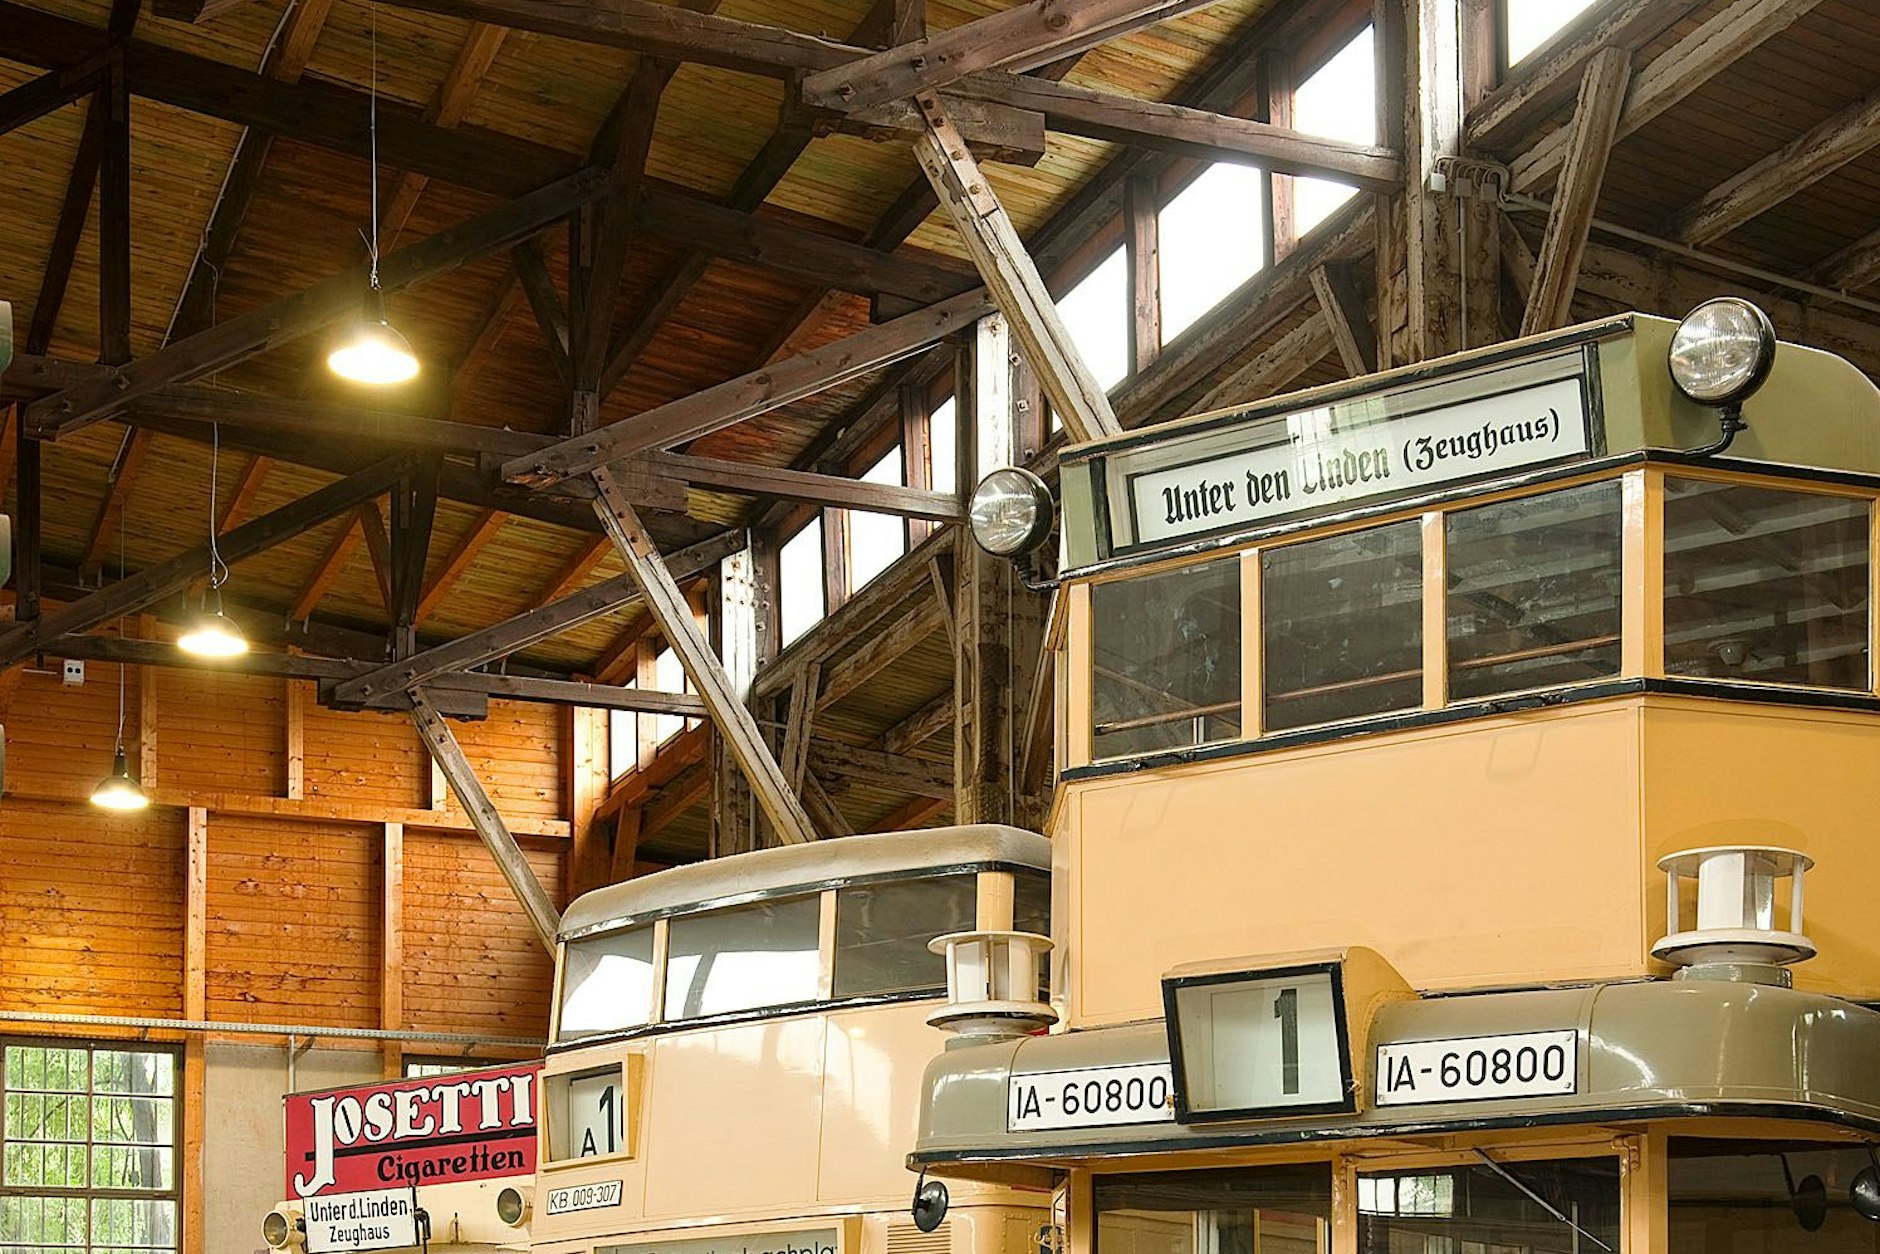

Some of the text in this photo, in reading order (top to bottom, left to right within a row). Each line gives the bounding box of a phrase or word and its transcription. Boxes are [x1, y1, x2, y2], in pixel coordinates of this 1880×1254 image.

[1162, 407, 1560, 525] Unter den Linden (Zeughaus)
[1273, 988, 1299, 1095] 1
[1385, 1044, 1566, 1093] IA-60800
[580, 1085, 623, 1158] A1
[1016, 1075, 1168, 1120] IA-60800
[293, 1073, 535, 1198] JOSETTI
[377, 1145, 525, 1185] Cigaretten
[550, 1184, 617, 1211] KB 009-307
[328, 1223, 391, 1247] Zeughaus
